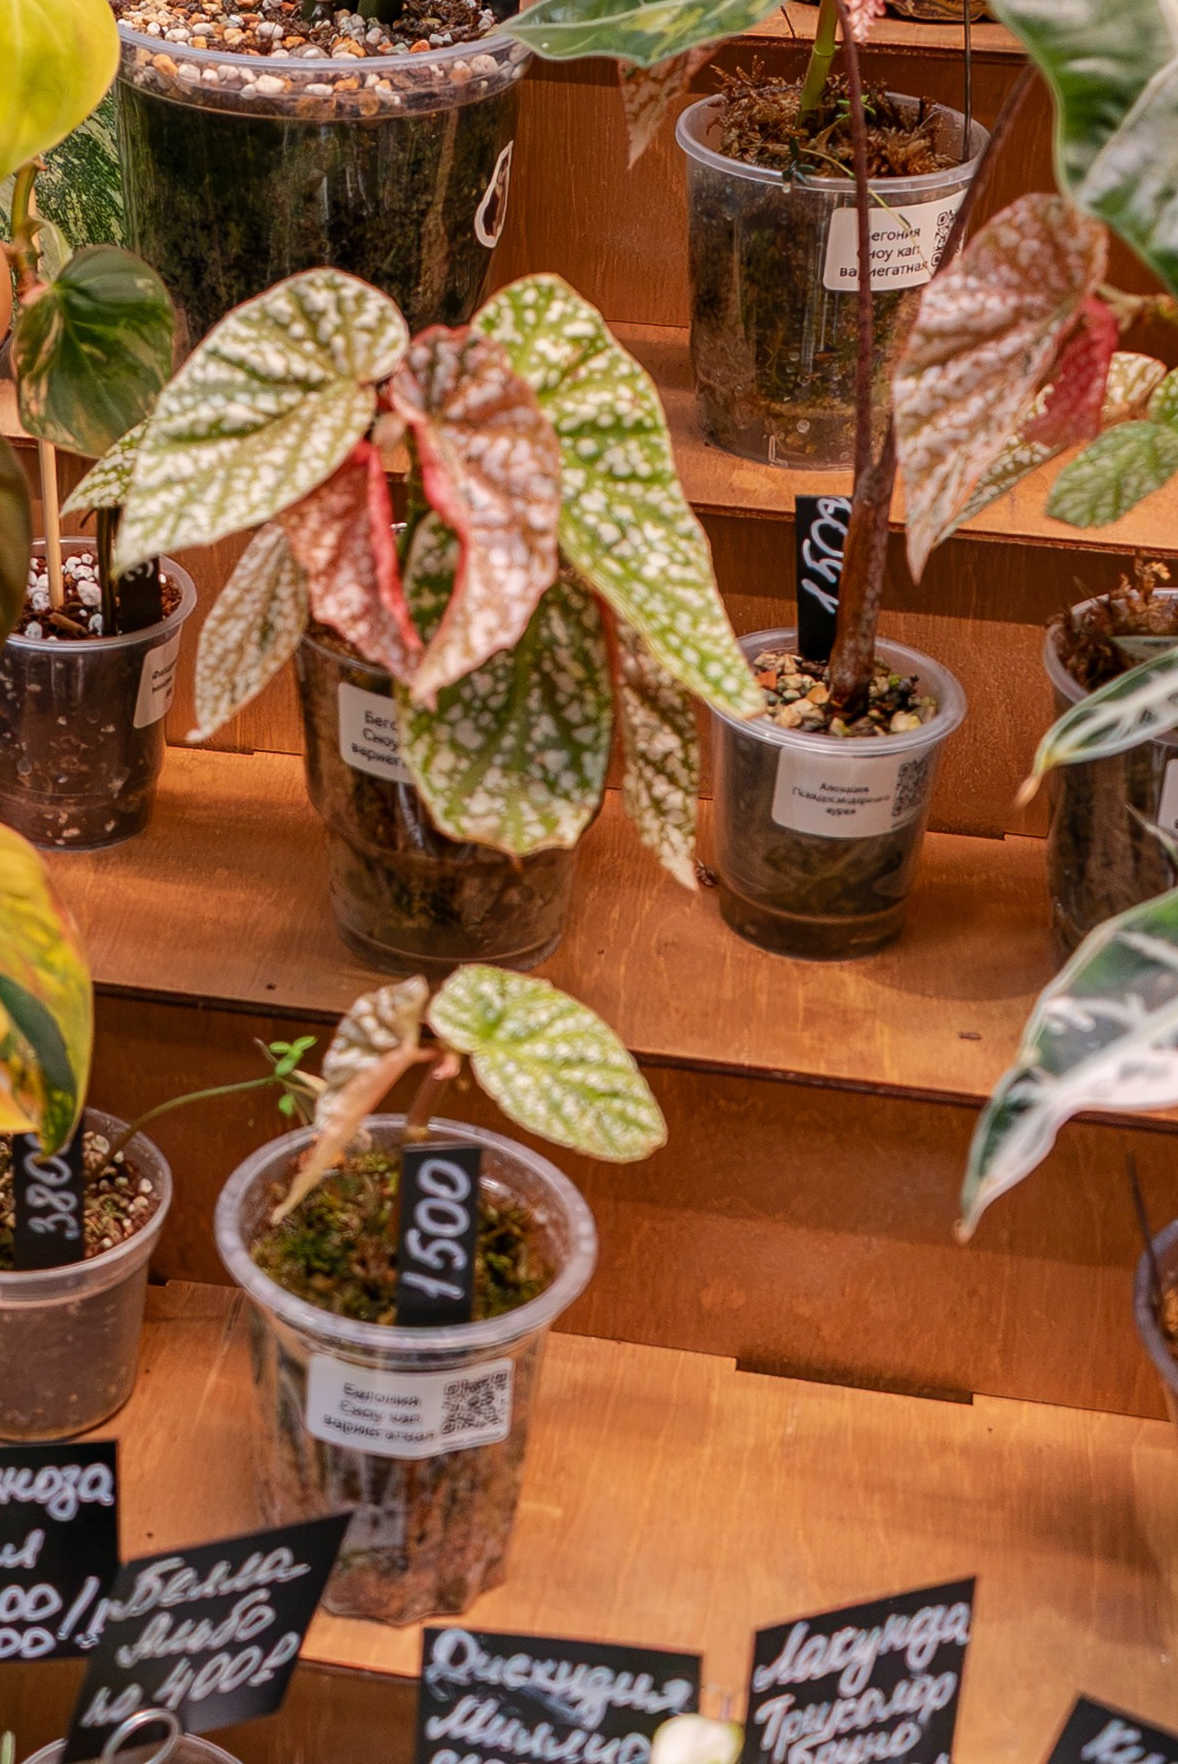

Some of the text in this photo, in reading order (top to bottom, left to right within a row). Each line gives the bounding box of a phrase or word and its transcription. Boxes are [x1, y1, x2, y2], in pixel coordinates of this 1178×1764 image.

[871, 227, 922, 242] егония
[839, 260, 928, 278] ваиегатная
[401, 1158, 472, 1300] 1500
